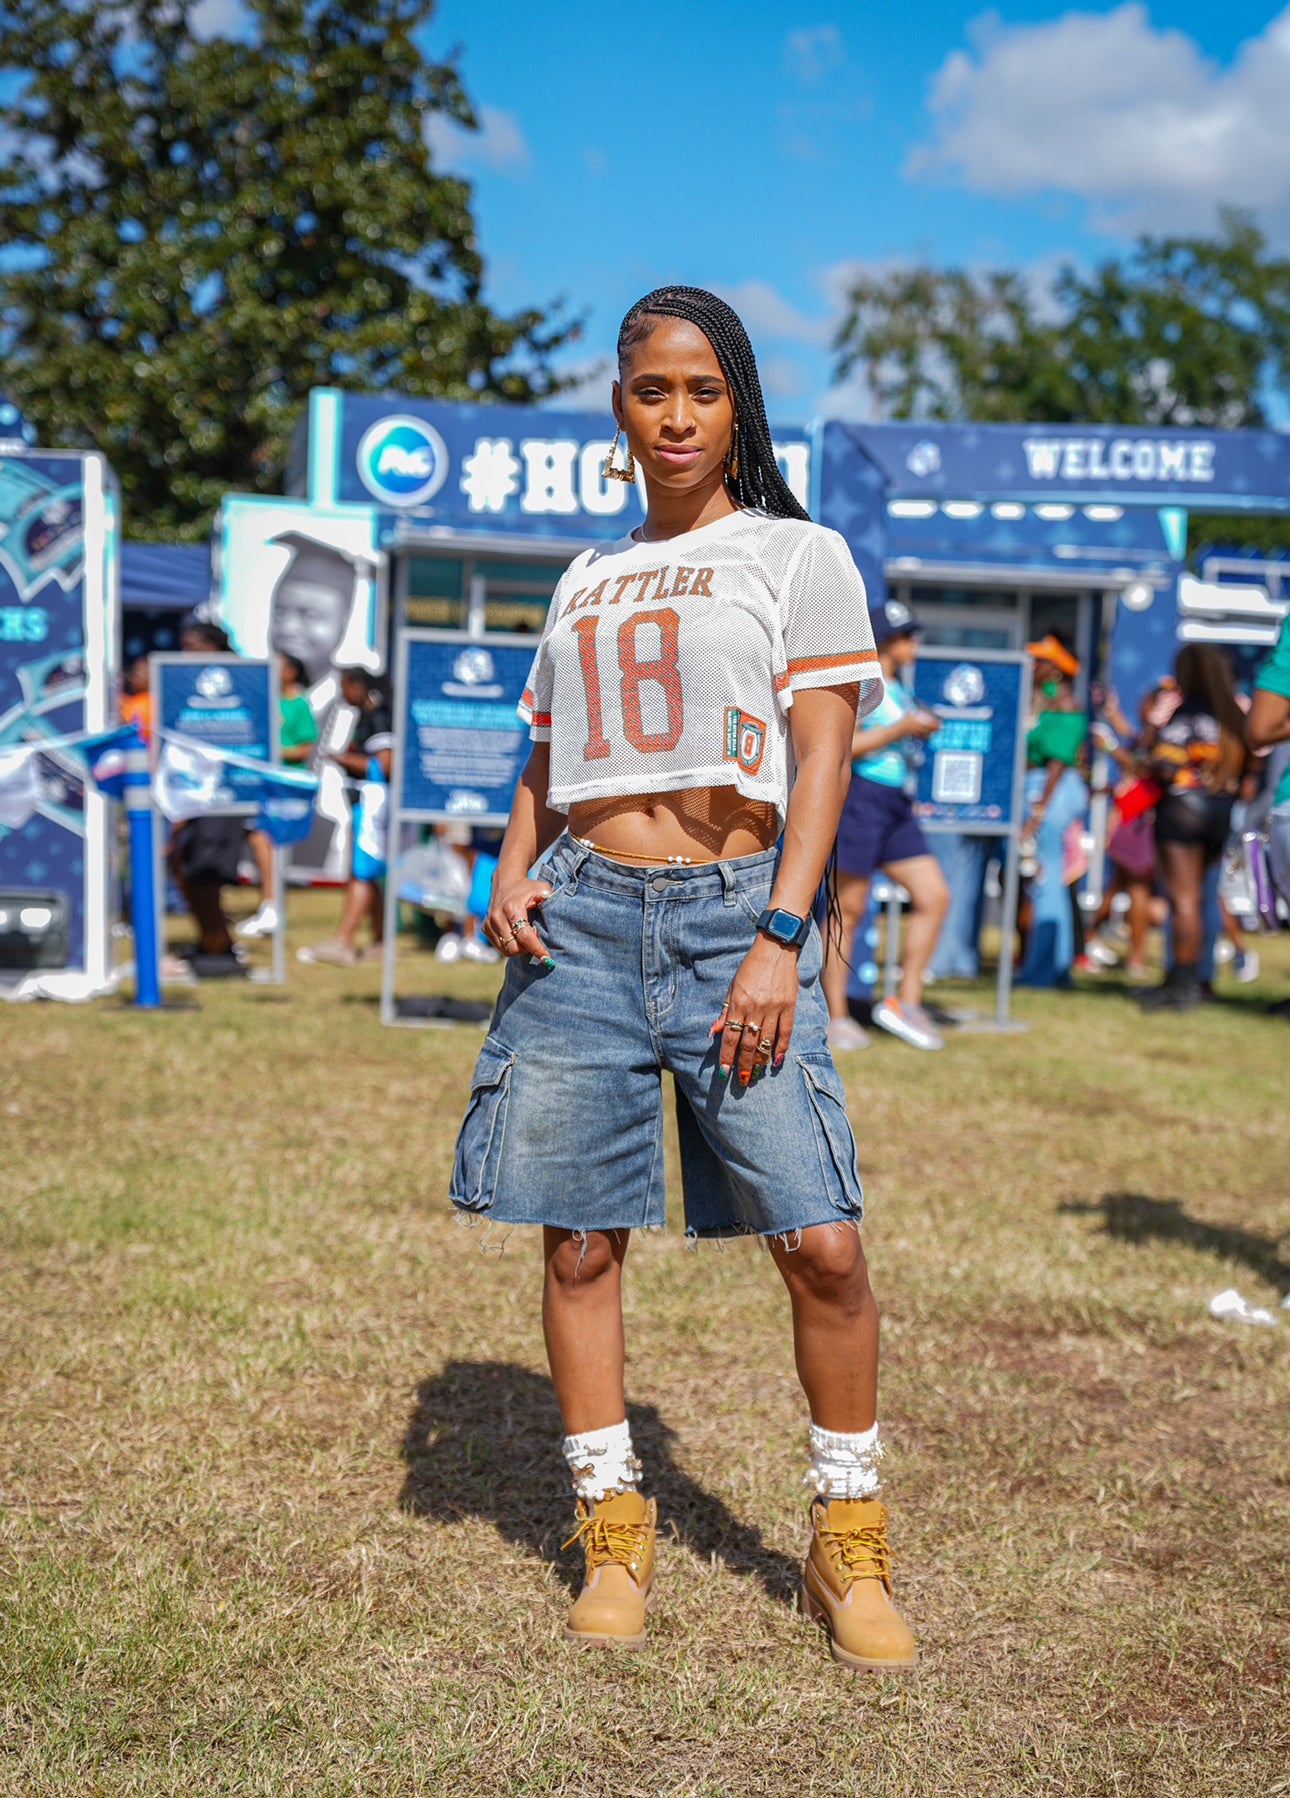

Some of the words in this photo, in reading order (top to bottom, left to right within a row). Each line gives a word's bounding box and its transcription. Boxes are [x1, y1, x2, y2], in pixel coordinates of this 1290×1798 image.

[1023, 438, 1214, 481] WELCOME
[561, 565, 714, 619] RATTLER
[571, 607, 684, 761] 18
